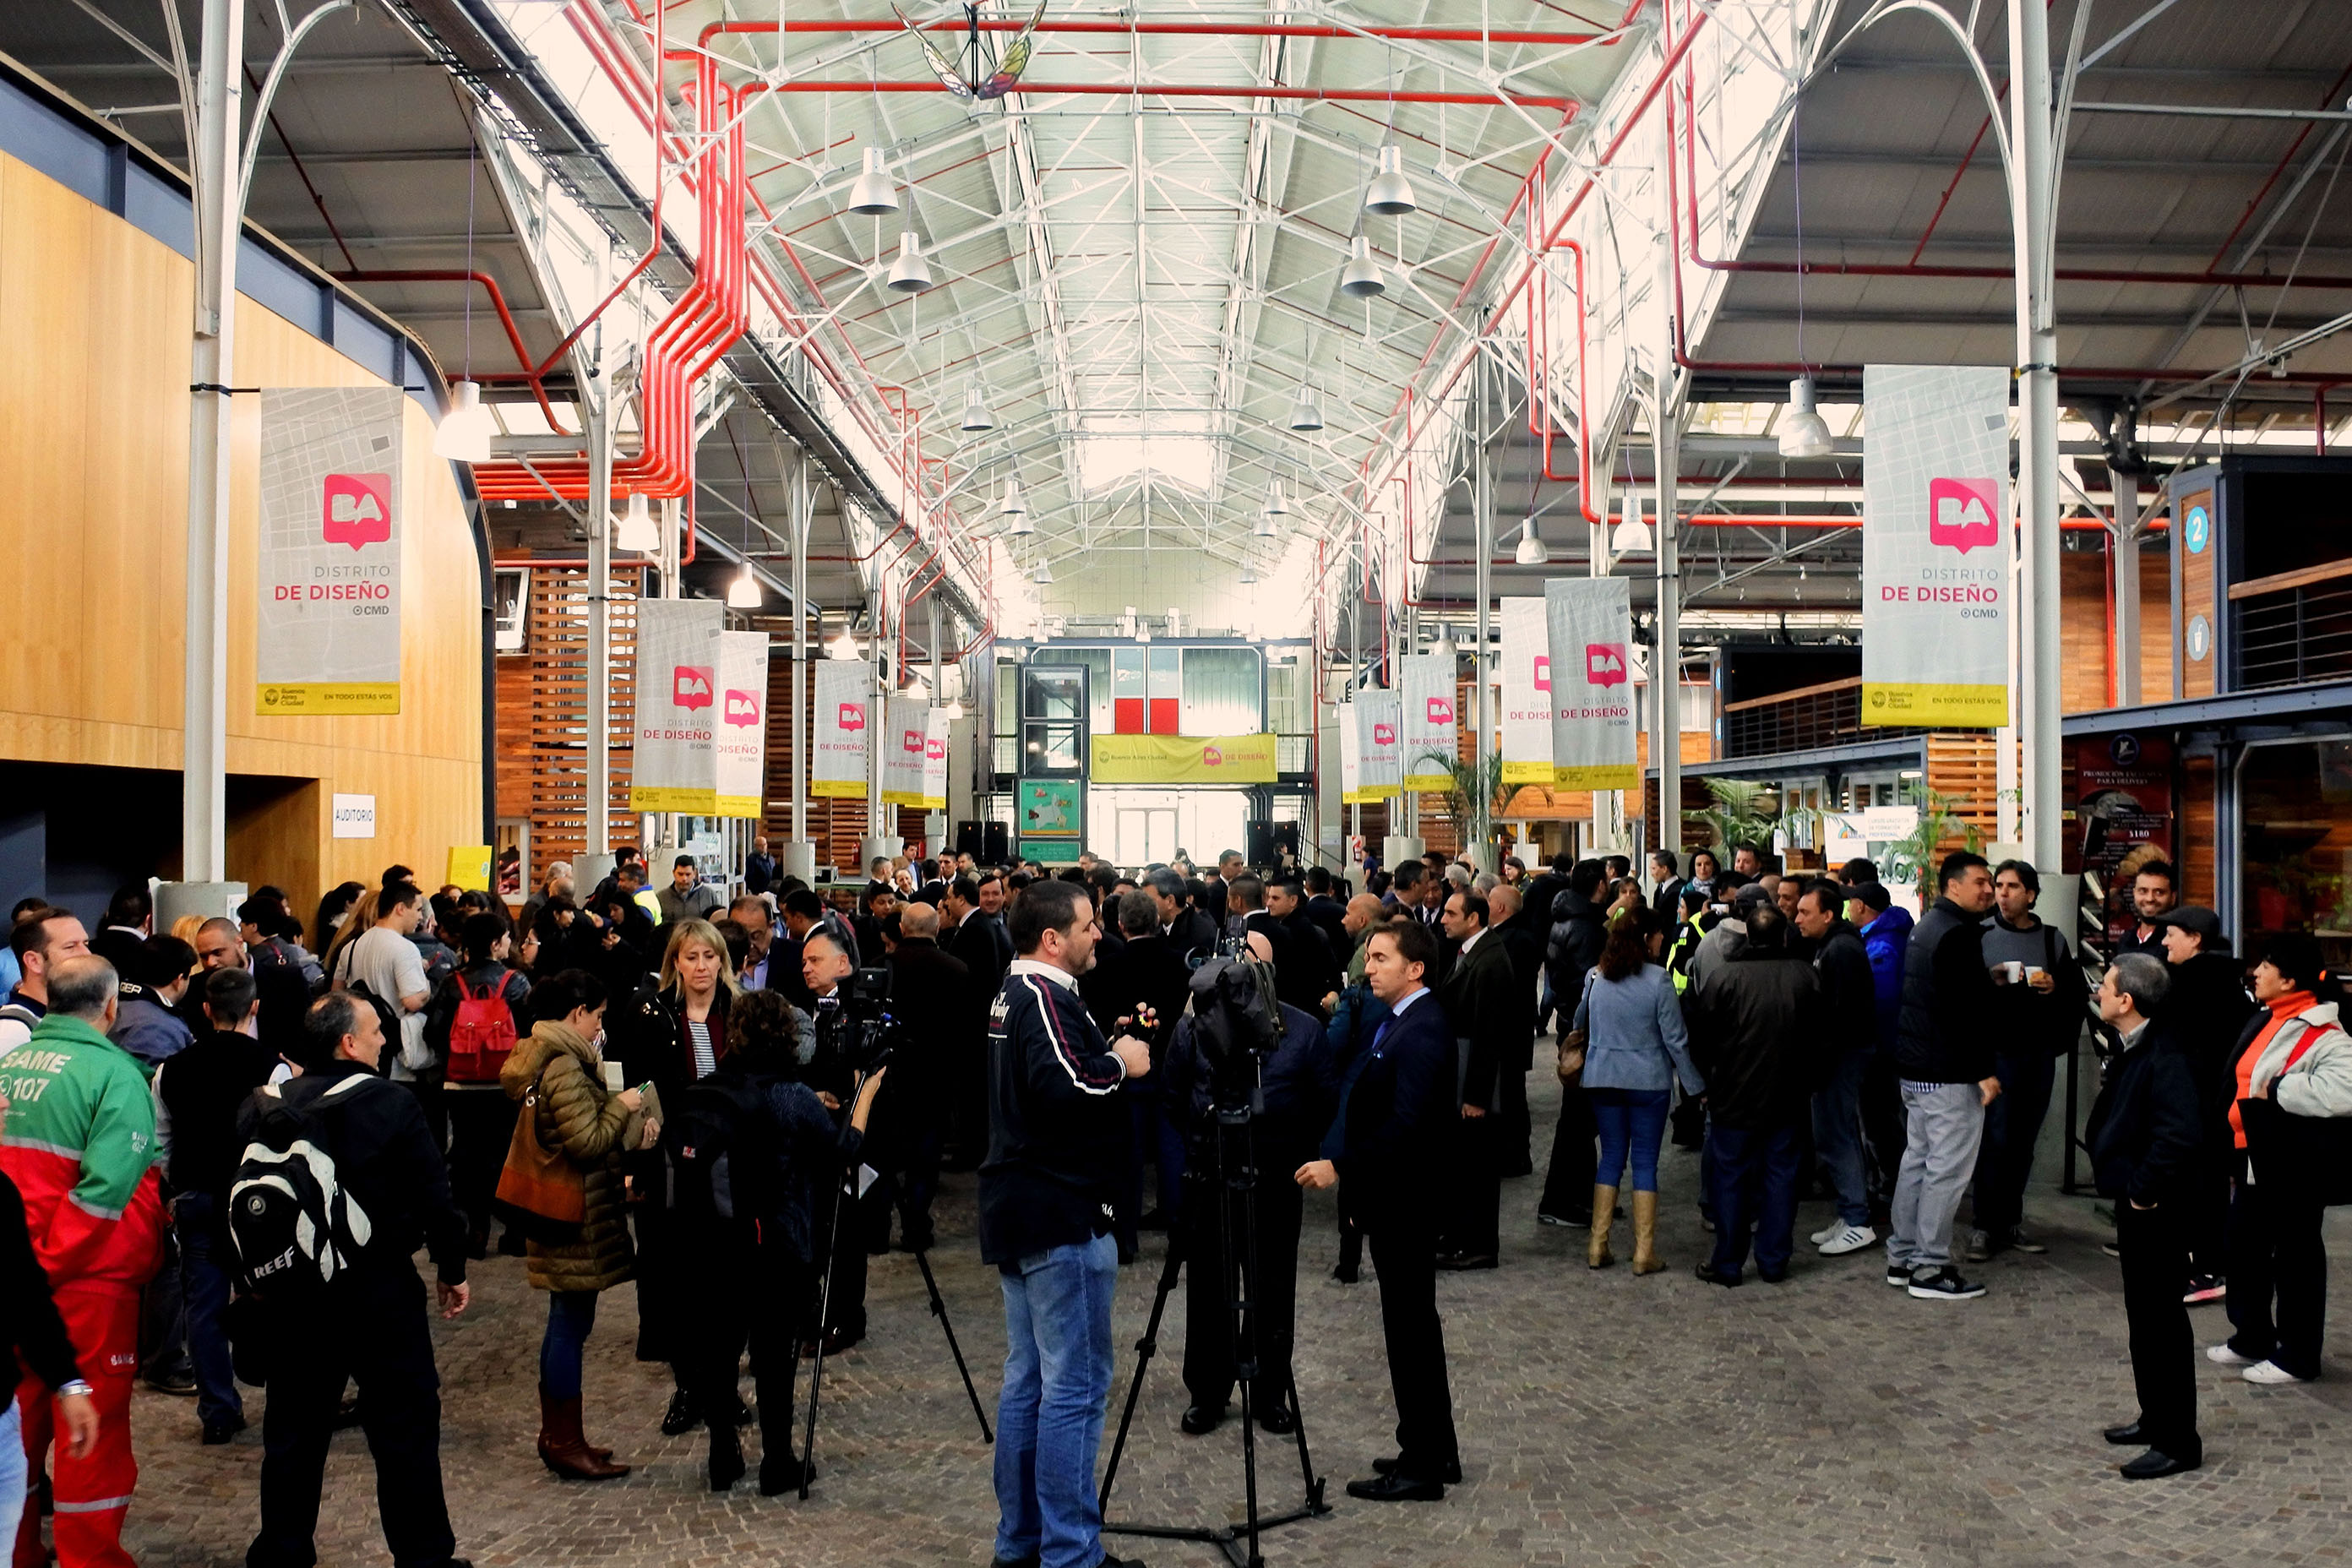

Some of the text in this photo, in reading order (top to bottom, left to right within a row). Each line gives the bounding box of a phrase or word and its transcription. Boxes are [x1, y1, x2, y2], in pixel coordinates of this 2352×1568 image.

[2192, 516, 2202, 542] 2
[314, 566, 390, 578] DISTRITO
[1922, 568, 1998, 580] DISTRITO
[275, 581, 390, 601] DE DISEÑO
[1881, 583, 1998, 602] DE DISEÑO
[364, 606, 389, 616] CMD
[1972, 608, 1998, 618] CMD
[1584, 696, 1628, 705] DISTRITO
[1511, 711, 1523, 720] DE
[1561, 707, 1628, 718] DE DISEÑO
[667, 719, 712, 727] DISTRITO
[644, 727, 712, 740] DE DISEÑO
[833, 743, 864, 751] DISEÑO
[1423, 737, 1454, 745] DISEÑO
[335, 808, 373, 822] AUDITORIO
[2129, 830, 2149, 838] $180
[2, 1050, 72, 1074] SAME
[13, 1076, 50, 1102] 107
[253, 1245, 295, 1279] REEF
